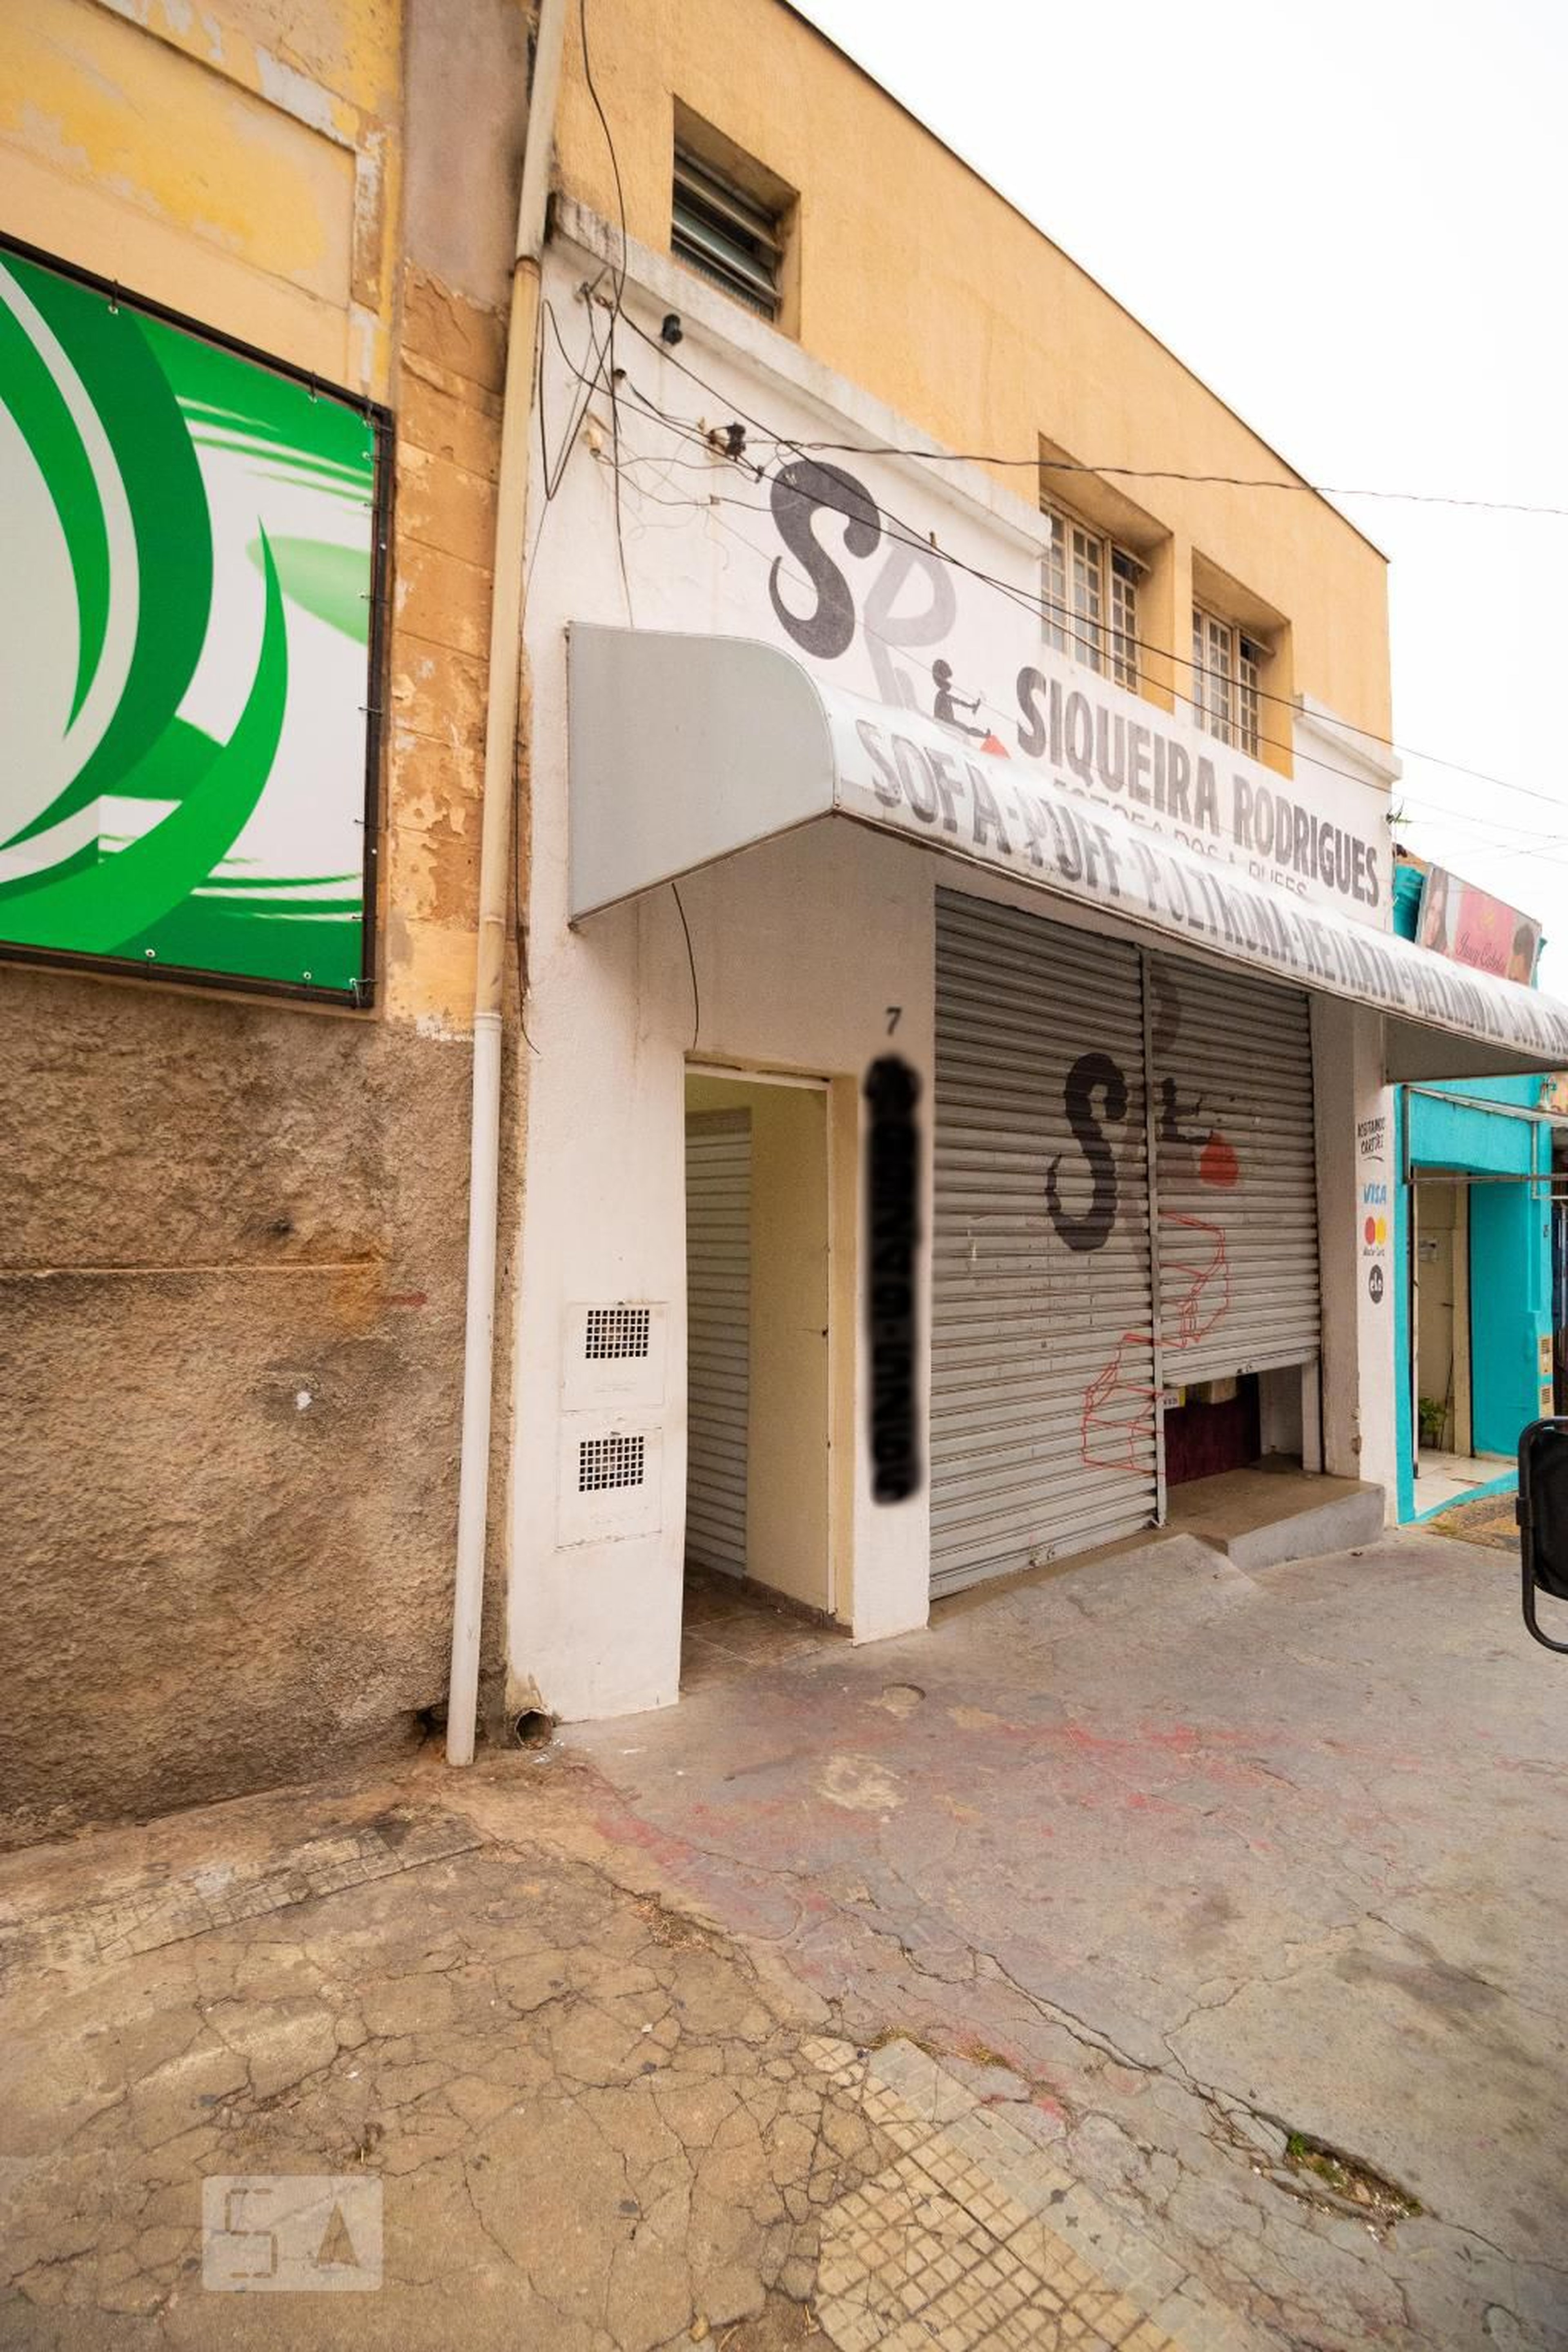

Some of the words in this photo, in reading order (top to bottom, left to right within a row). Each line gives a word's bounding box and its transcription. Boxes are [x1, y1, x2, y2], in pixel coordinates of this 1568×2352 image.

[1016, 666, 1221, 837] SIQUEIRA
[1232, 774, 1379, 907] RODRIGUES
[886, 1007, 902, 1036] 7
[1364, 1183, 1387, 1204] VISA
